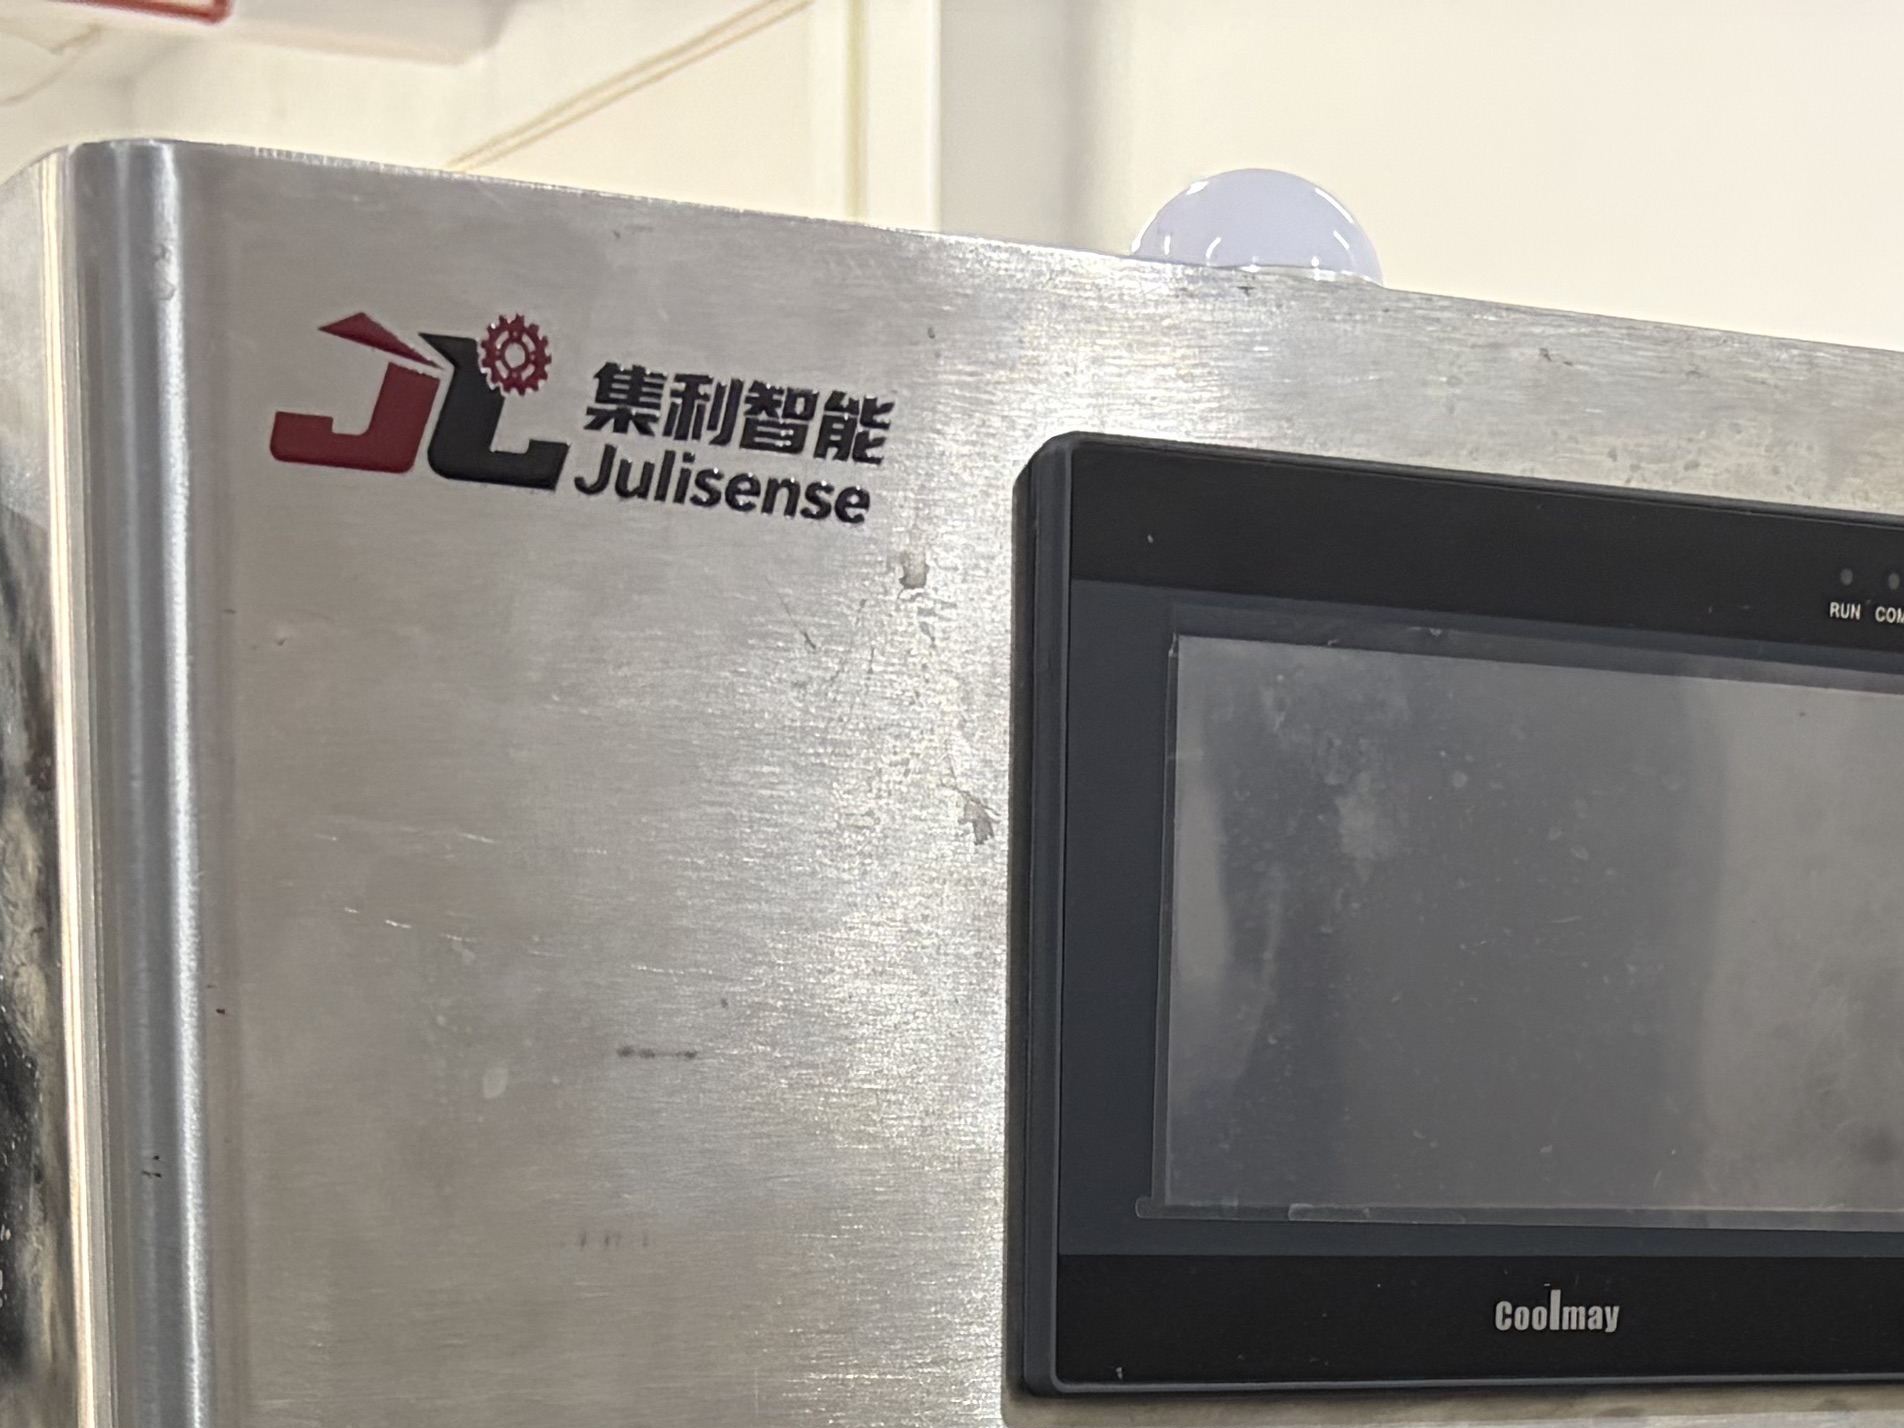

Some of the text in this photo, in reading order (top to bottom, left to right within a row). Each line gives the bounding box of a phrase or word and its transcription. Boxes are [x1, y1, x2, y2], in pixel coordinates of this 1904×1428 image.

[584, 362, 895, 465] 集利智能
[574, 443, 870, 524] Julisense
[1829, 602, 1861, 620] RUN
[1495, 1289, 1620, 1333] Coolmay
